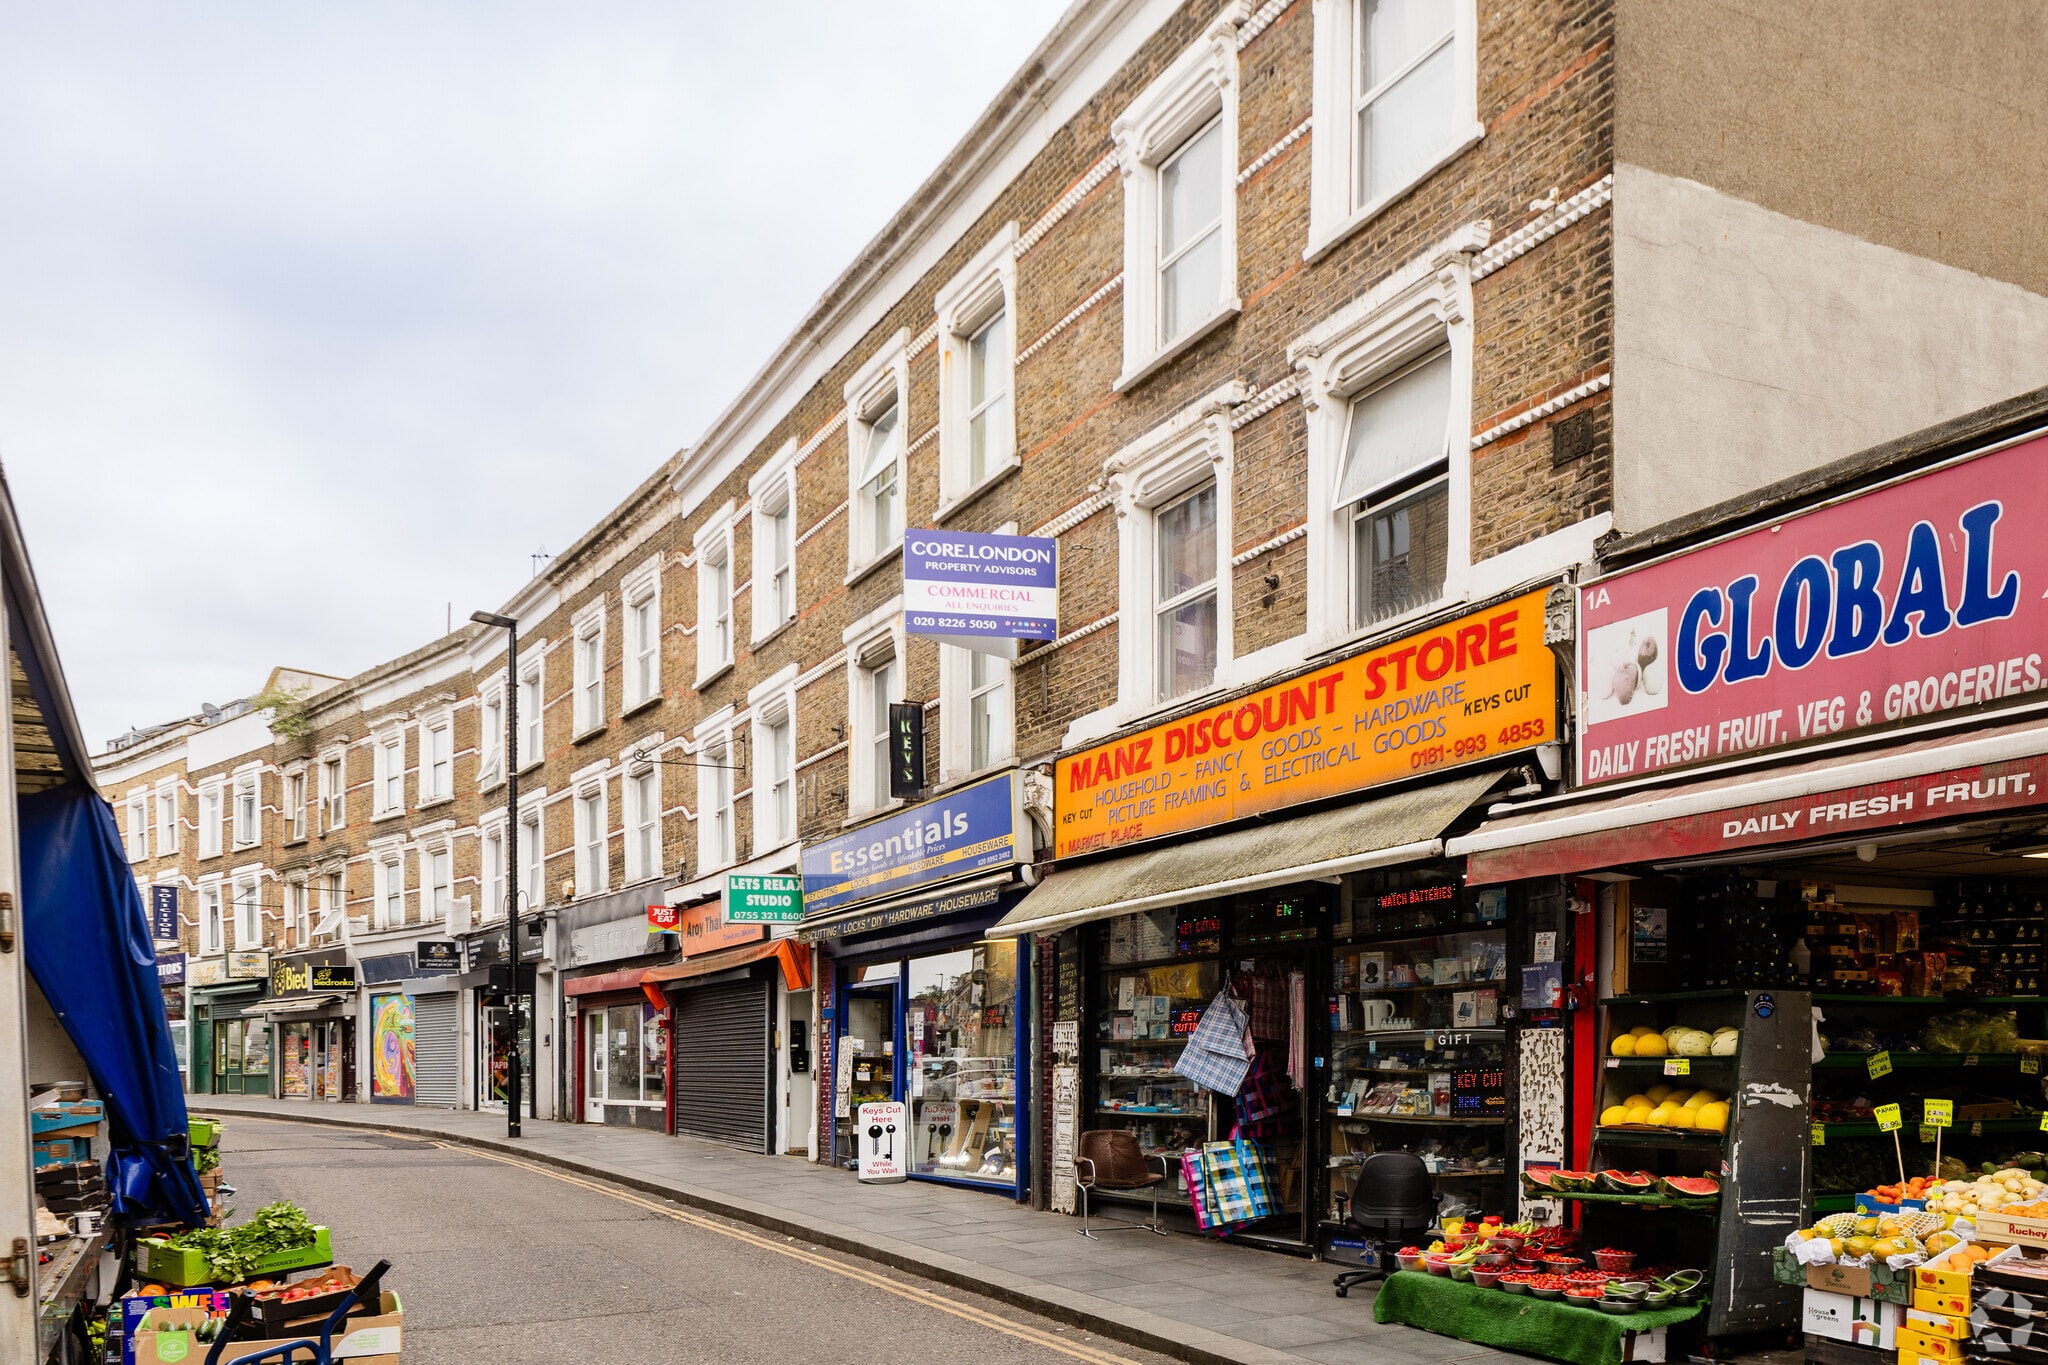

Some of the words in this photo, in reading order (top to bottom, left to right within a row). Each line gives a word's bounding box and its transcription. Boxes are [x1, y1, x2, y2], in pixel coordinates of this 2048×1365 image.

[911, 541, 1050, 564] CORE.LONDON
[925, 561, 980, 573] PROPERTY
[983, 565, 1037, 577] ADVISORS
[927, 585, 1034, 602] COMMERCIAL
[1585, 587, 1611, 611] 1A
[1675, 499, 2021, 695] GLOBAL
[944, 601, 964, 609] ALL
[966, 602, 1018, 613] ENQUIRIES
[913, 616, 935, 627] 020
[938, 617, 966, 628] 8226
[969, 618, 997, 630] 5050
[1069, 737, 1153, 793] MANZ
[1165, 671, 1344, 765] DISCOUNT
[1365, 609, 1519, 700] STORE
[1463, 694, 1500, 717] KEYS
[1504, 683, 1531, 703] CUT
[1498, 718, 1544, 746] 4853
[1587, 740, 1639, 780] DAILY
[1644, 724, 1710, 769] FRESH
[1717, 708, 1788, 754] FRUIT,
[1797, 696, 1846, 738] VEG
[1855, 690, 1873, 727] &
[1094, 771, 1171, 808] HOUSEHOLD
[1195, 749, 1243, 780] FANCY
[1261, 726, 1321, 760] GOODS
[1354, 680, 1465, 733] HARDWARE
[1107, 798, 1155, 825] PICTURE
[1163, 778, 1226, 811] FRAMING
[1239, 772, 1251, 791] &
[1264, 742, 1360, 785] ELECTRICAL
[1373, 716, 1446, 754] GOODS
[1722, 809, 1801, 839] DAILY
[1809, 791, 1914, 825] FRESH
[1926, 772, 2036, 806] FRUIT,
[1062, 811, 1076, 825] KEY
[1080, 808, 1093, 820] CUT
[830, 809, 969, 874] Essentials
[1059, 842, 1064, 854] 1
[1068, 832, 1106, 853] MARKET
[1110, 823, 1143, 843] PLACE
[927, 844, 946, 854] Prices
[850, 877, 869, 889] LOCKS
[883, 870, 893, 880] DIY
[908, 855, 945, 873] HARDWARE
[962, 836, 1009, 857] HOUSEWARE
[730, 877, 760, 890] LETS
[746, 894, 792, 907] STUDIO
[1380, 892, 1407, 908] WATCH
[1409, 886, 1452, 903] BATTERIES
[158, 888, 172, 937] SOLICITORS
[652, 908, 675, 916] JUST
[657, 915, 675, 923] EAT
[734, 911, 757, 920] 0755
[761, 911, 778, 920] 321
[781, 911, 804, 920] 8600
[810, 926, 837, 940] CUTTING
[843, 919, 866, 933] LOCKS
[871, 915, 884, 928] DIY
[888, 901, 934, 924] HARDWARE
[939, 888, 998, 912] HOUSEWARE
[686, 921, 703, 939] Aroy
[705, 913, 722, 932] Thai
[285, 962, 309, 990] Bied
[313, 978, 354, 986] Biedronka
[1180, 1012, 1199, 1022] KEY
[1438, 1033, 1472, 1045] GIFT
[1867, 1056, 1889, 1067] LETTUCE
[1457, 1073, 1477, 1088] KEY
[862, 1107, 884, 1115] Keys
[885, 1106, 901, 1114] Cut
[265, 1260, 293, 1269] PRODUCE
[152, 1293, 229, 1312] SWEE
[1808, 1306, 1829, 1315] House
[1816, 1313, 1839, 1322] greens
